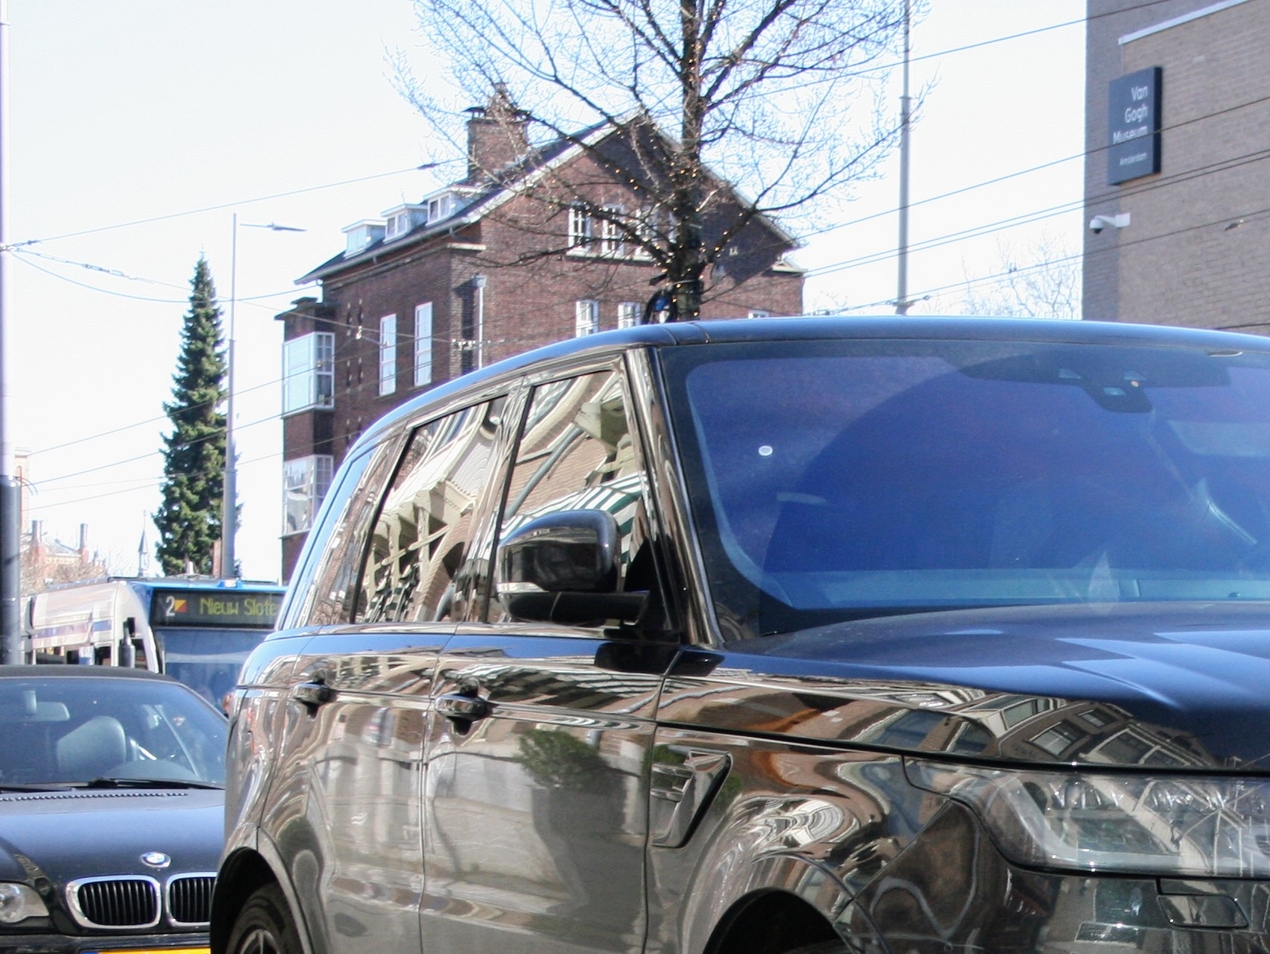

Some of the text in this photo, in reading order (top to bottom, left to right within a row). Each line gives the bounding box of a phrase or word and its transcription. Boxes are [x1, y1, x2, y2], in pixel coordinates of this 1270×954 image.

[1131, 86, 1148, 101] Van
[1124, 104, 1148, 123] Gogh
[1112, 126, 1148, 145] Museum
[165, 596, 280, 616] 2 Nieuw Slote
